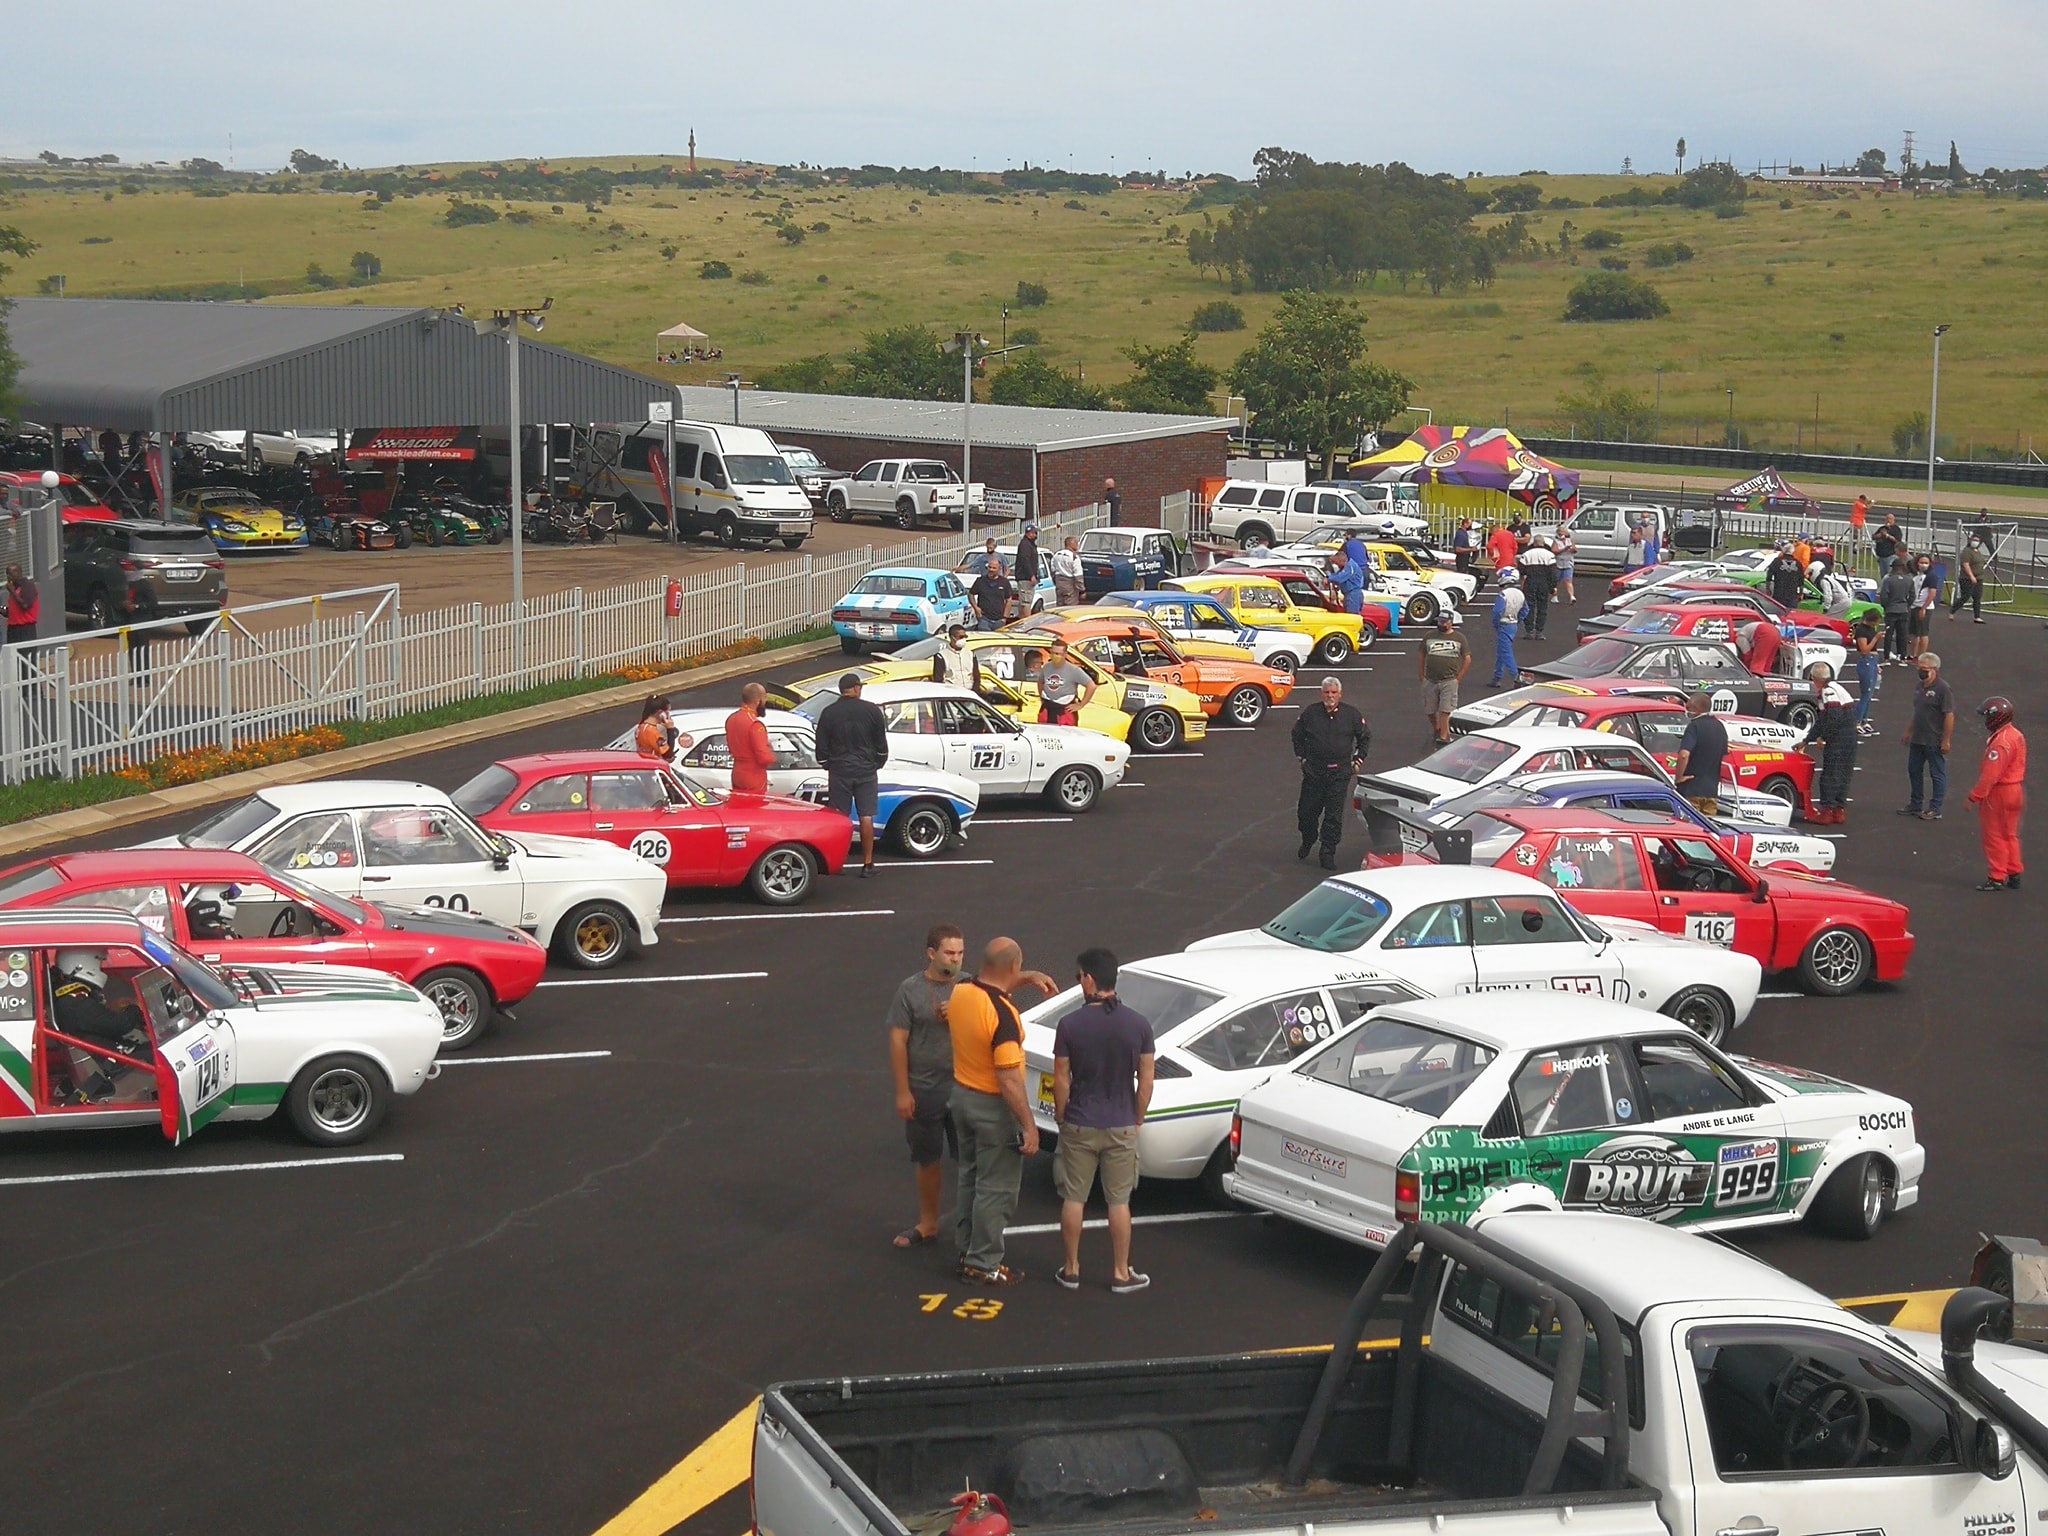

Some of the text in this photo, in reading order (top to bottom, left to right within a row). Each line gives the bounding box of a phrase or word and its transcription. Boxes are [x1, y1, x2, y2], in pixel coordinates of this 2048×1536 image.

[393, 438, 453, 448] RACING
[1741, 726, 1796, 739] DATSUN
[707, 744, 730, 752] Andr
[973, 751, 1002, 768] 121
[306, 841, 347, 851] Armstrong
[632, 839, 668, 859] 126
[1694, 920, 1725, 940] 116
[197, 1052, 220, 1102] 124
[1682, 1113, 1756, 1132] ANDRE DE LANGE
[1859, 1111, 1907, 1131] BOSCH
[1283, 1140, 1346, 1171] Roofsure
[1720, 1161, 1776, 1201] 999
[1366, 1230, 1386, 1243] TOW
[1963, 1511, 2015, 1528] HILUX
